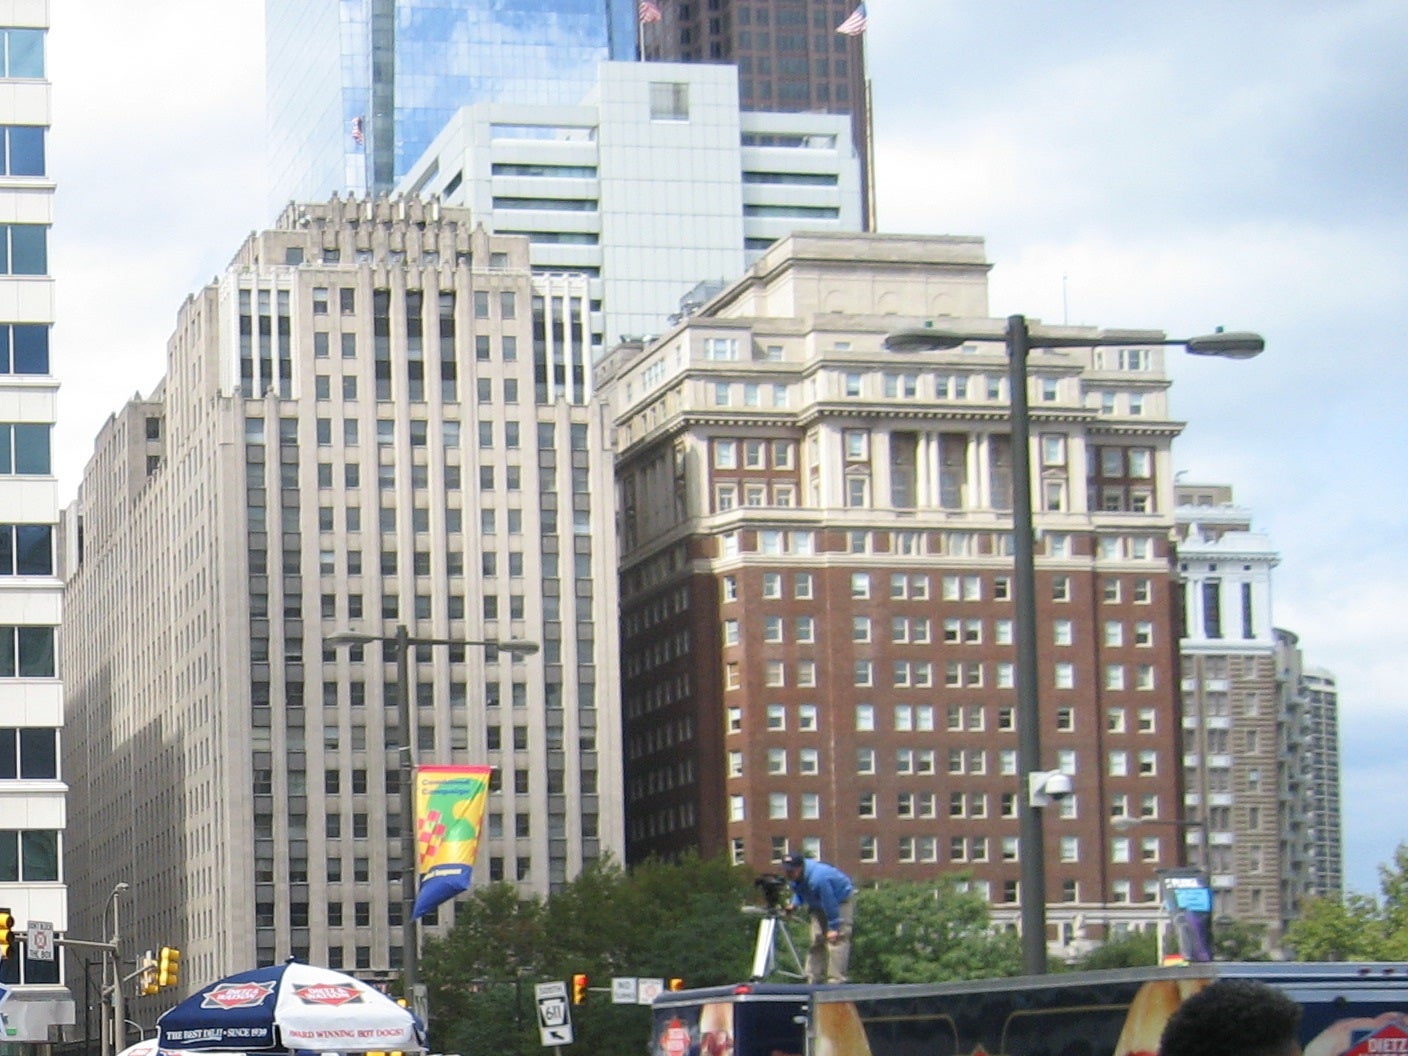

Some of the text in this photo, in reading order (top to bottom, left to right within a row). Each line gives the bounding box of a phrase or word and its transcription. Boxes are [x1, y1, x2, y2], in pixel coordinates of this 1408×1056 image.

[166, 1031, 183, 1040] THE
[184, 1030, 203, 1038] BEST
[227, 1028, 250, 1037] SINCE
[251, 1028, 267, 1037] 1939
[316, 1029, 355, 1038] WINNING
[357, 1029, 374, 1038] HOT
[1368, 1038, 1408, 1052] DIETZ
